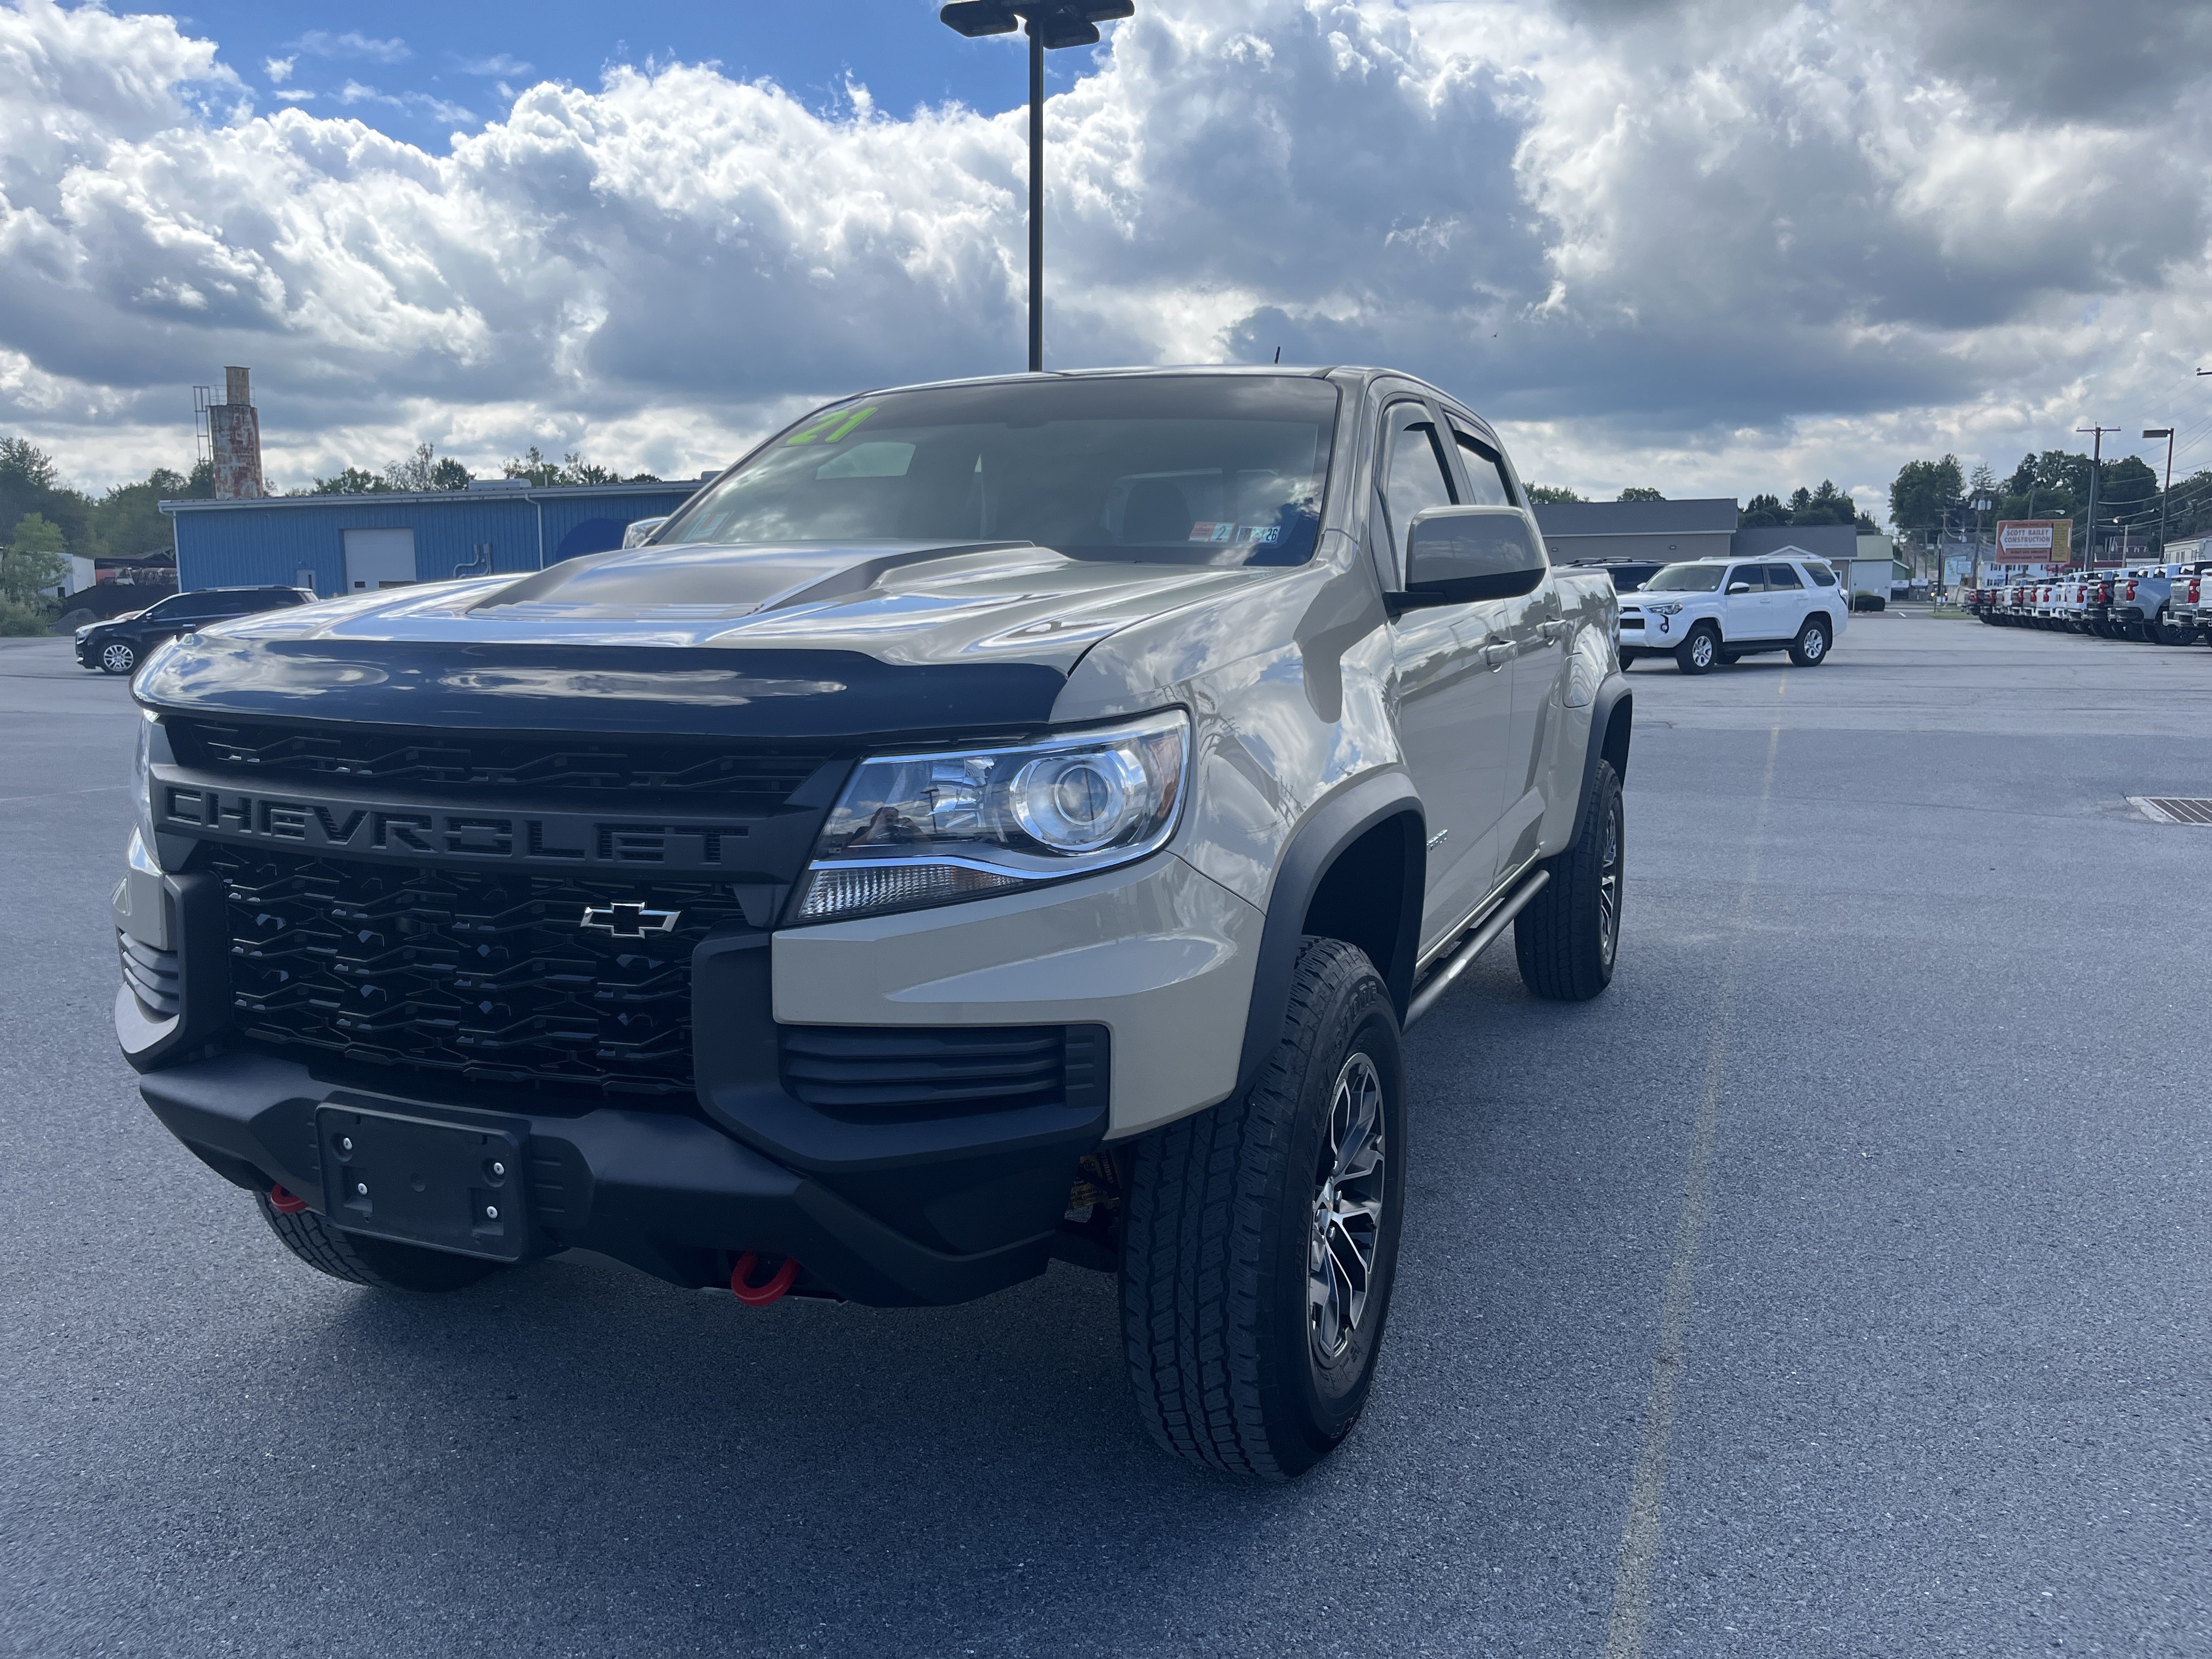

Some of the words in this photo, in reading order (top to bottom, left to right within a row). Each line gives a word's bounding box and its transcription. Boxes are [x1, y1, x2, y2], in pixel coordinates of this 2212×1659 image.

[786, 407, 878, 444] 21
[1266, 528, 1278, 541] 26
[166, 785, 752, 866] CHEVROLET
